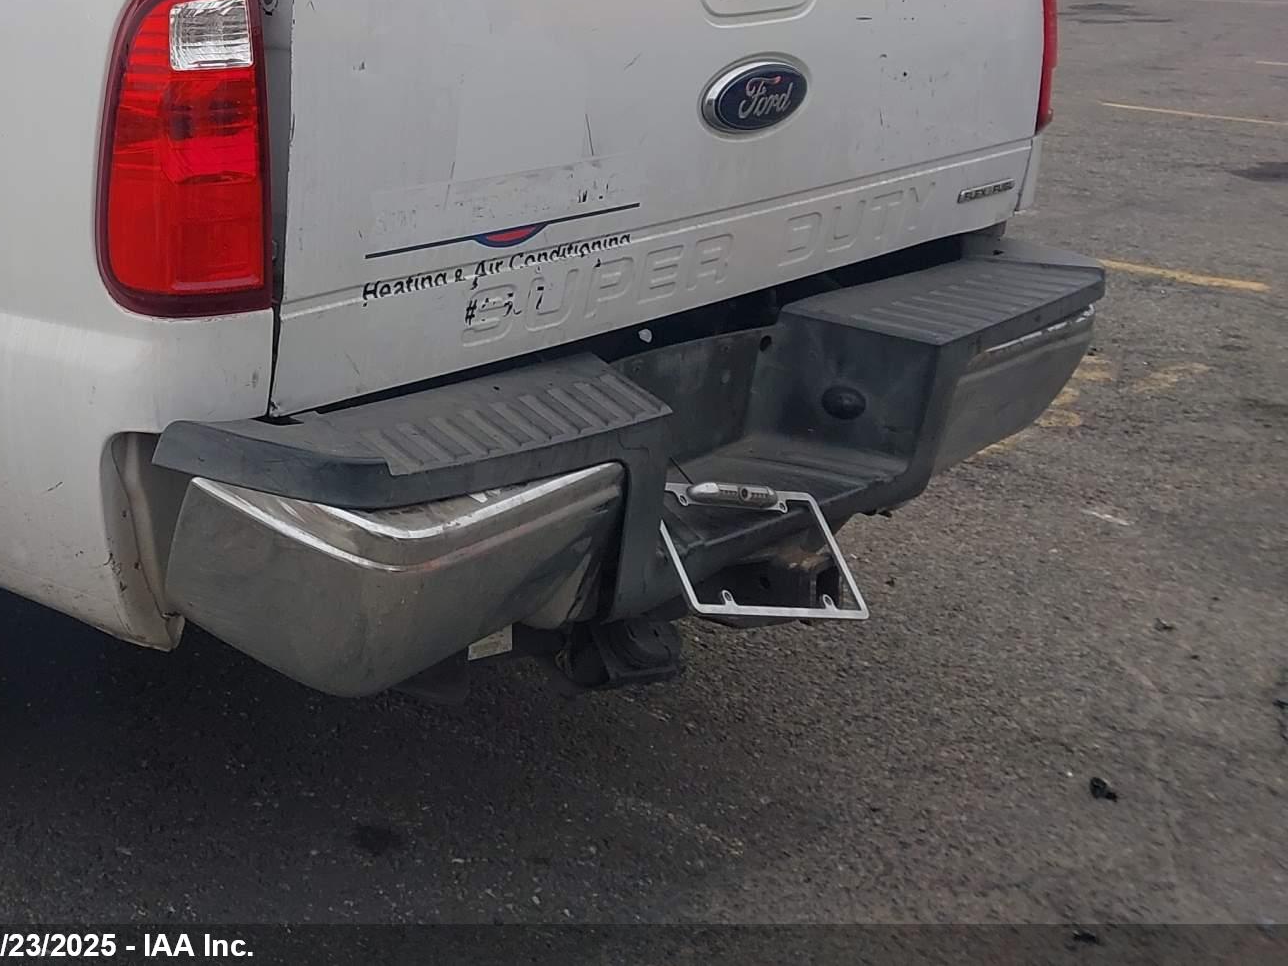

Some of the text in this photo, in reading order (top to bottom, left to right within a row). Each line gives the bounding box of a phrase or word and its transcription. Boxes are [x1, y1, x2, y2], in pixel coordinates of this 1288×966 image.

[738, 75, 794, 119] Ford
[462, 233, 735, 348] SUPER
[777, 182, 938, 268] DUTY
[471, 257, 504, 286] Air
